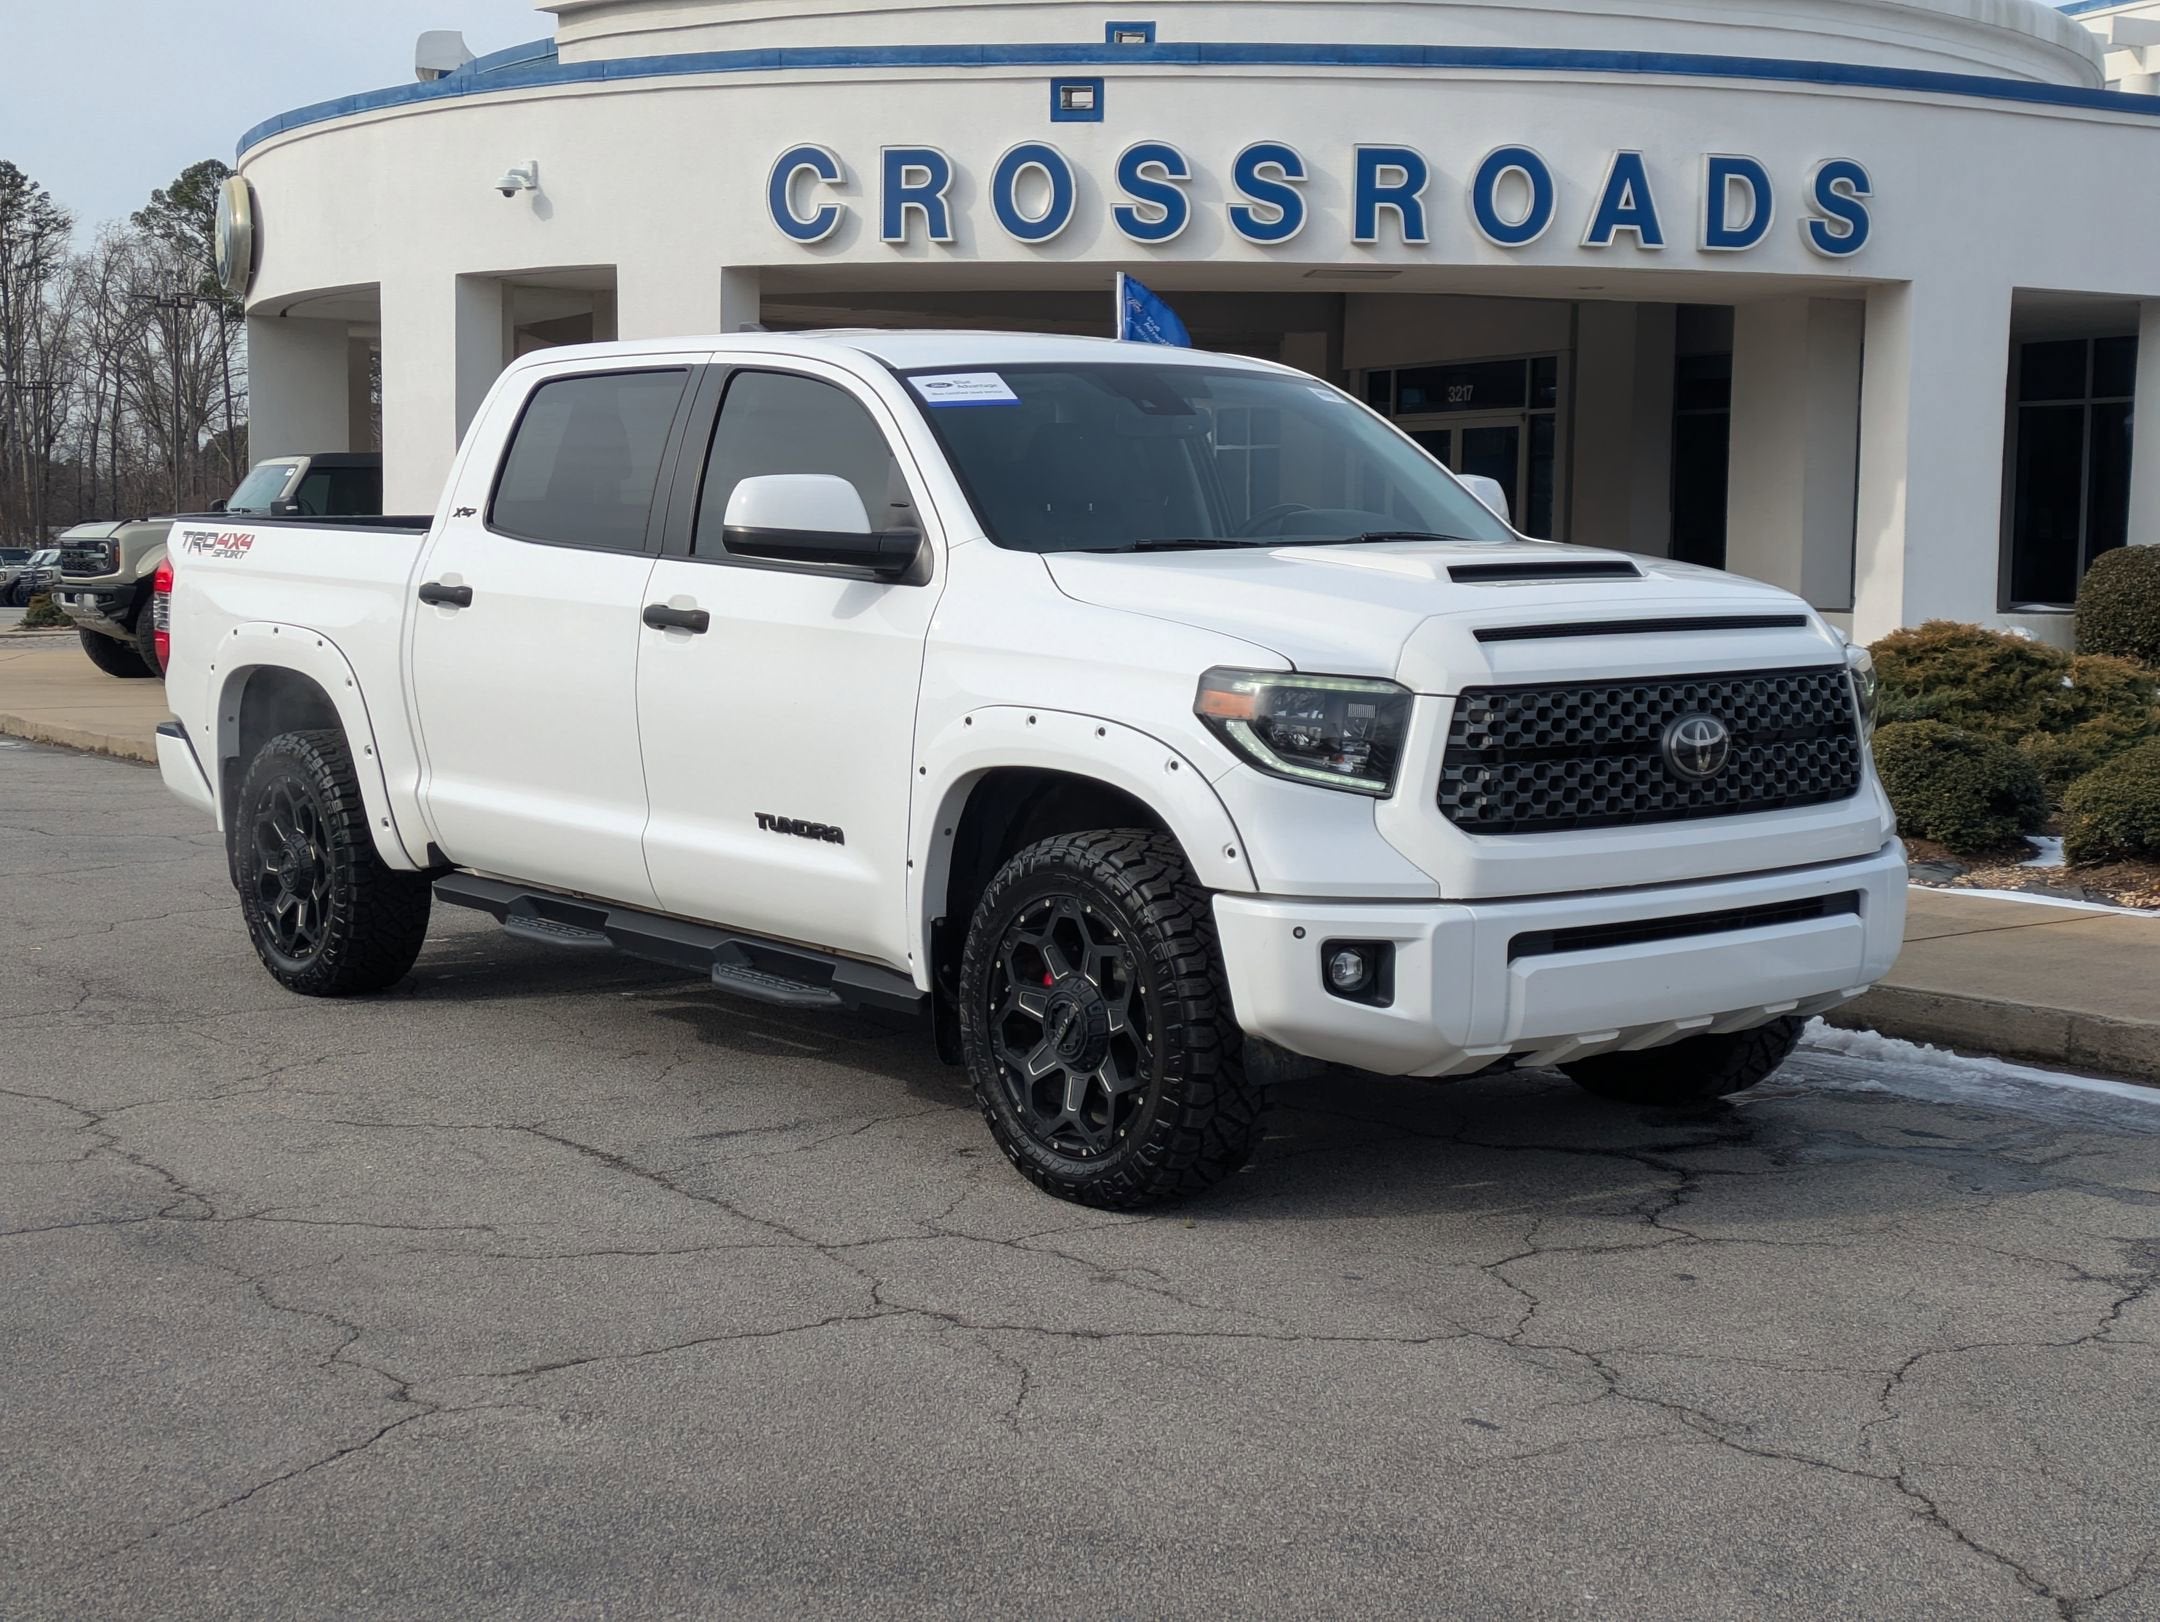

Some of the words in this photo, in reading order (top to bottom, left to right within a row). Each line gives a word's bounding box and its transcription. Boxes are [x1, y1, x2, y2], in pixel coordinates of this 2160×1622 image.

[766, 139, 1874, 259] CROSSROADS
[1448, 385, 1473, 402] 3217
[212, 549, 247, 559] SPORT
[754, 811, 845, 846] TUNDRA
